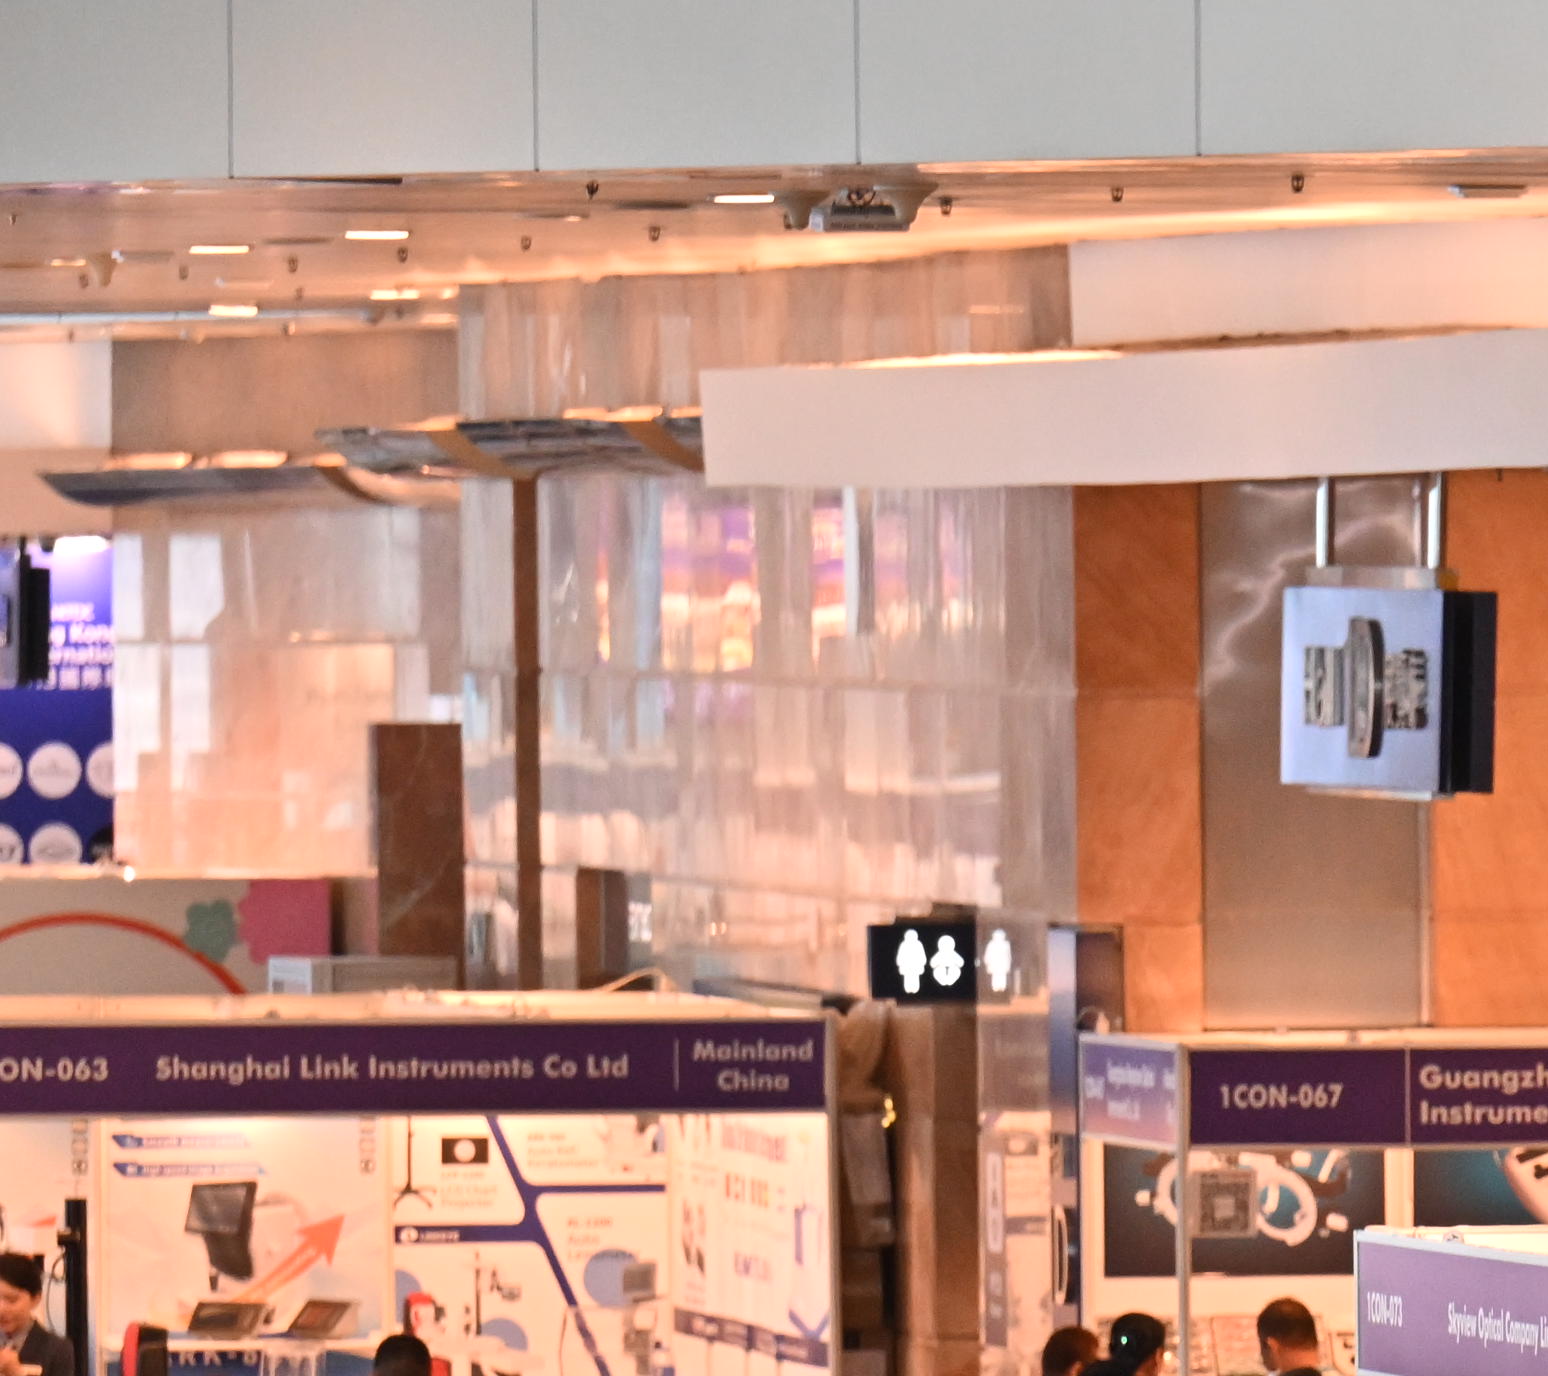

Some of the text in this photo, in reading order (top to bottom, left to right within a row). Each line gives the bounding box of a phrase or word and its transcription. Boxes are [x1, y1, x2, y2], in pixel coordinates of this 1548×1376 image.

[692, 1038, 814, 1062] Mainland
[155, 1053, 291, 1086] Shanghai
[300, 1053, 359, 1080] Link
[368, 1054, 535, 1079] Instruments
[542, 1054, 578, 1079] Co
[586, 1053, 629, 1078] Ltd
[717, 1068, 790, 1092] China
[1220, 1082, 1344, 1109] 1CON-067
[1366, 1290, 1403, 1328] 1CON-073
[1447, 1301, 1477, 1344] Skyview
[1477, 1307, 1504, 1349] Optical
[1504, 1311, 1539, 1356] Company
